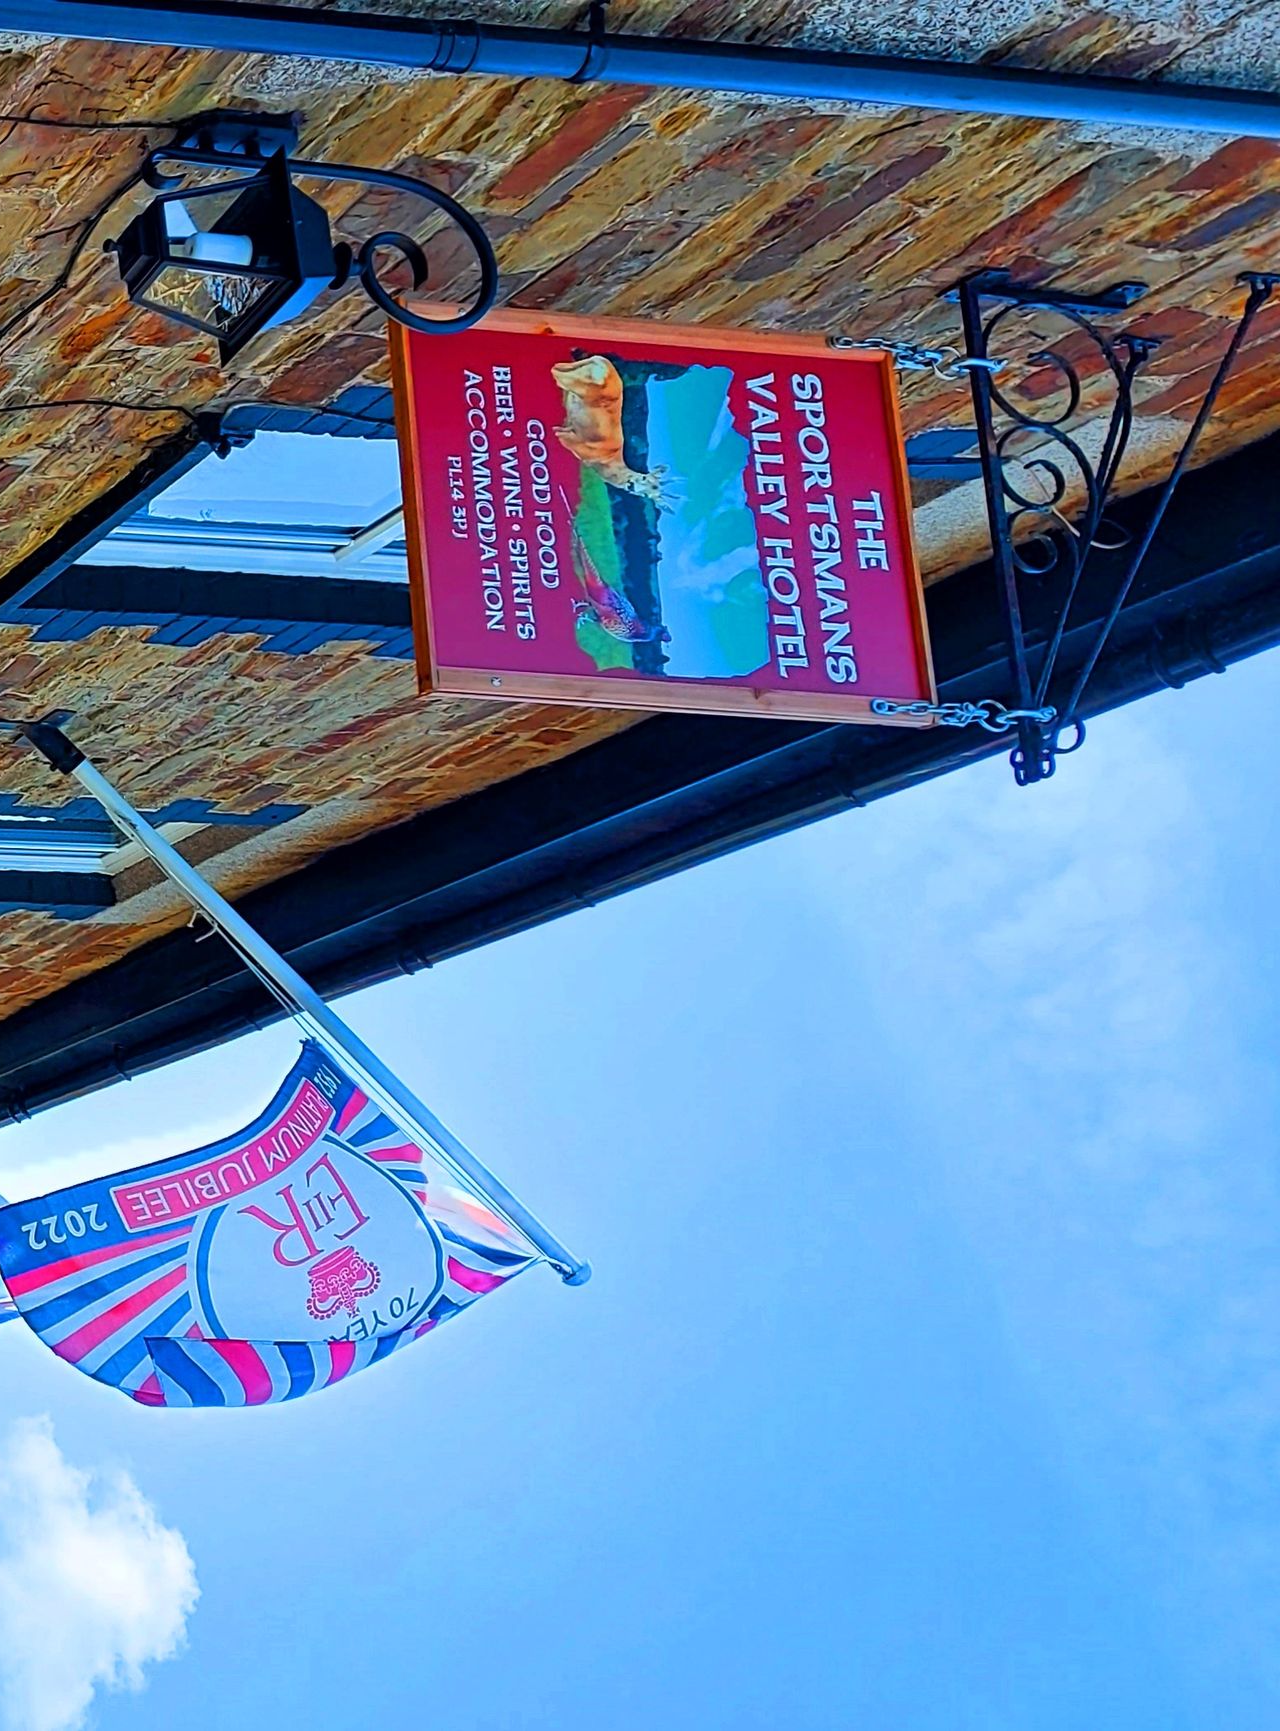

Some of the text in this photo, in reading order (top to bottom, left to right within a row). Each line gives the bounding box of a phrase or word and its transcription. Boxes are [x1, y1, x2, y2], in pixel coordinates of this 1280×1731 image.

[448, 456, 468, 539] PL14 3PJ
[464, 369, 507, 631] ACCOMMODATION
[493, 366, 536, 640] BEER WINE SPIRITS
[526, 419, 560, 589] GOOD FOOD
[745, 372, 809, 678] VALLEY HOTEL
[791, 373, 858, 683] SPORTSMANS
[852, 491, 890, 571] THE
[257, 1086, 329, 1172] PLATINUM
[20, 1203, 108, 1251] 2022
[125, 1151, 257, 1221] JUBILEE
[327, 1287, 419, 1343] 70 YEA
